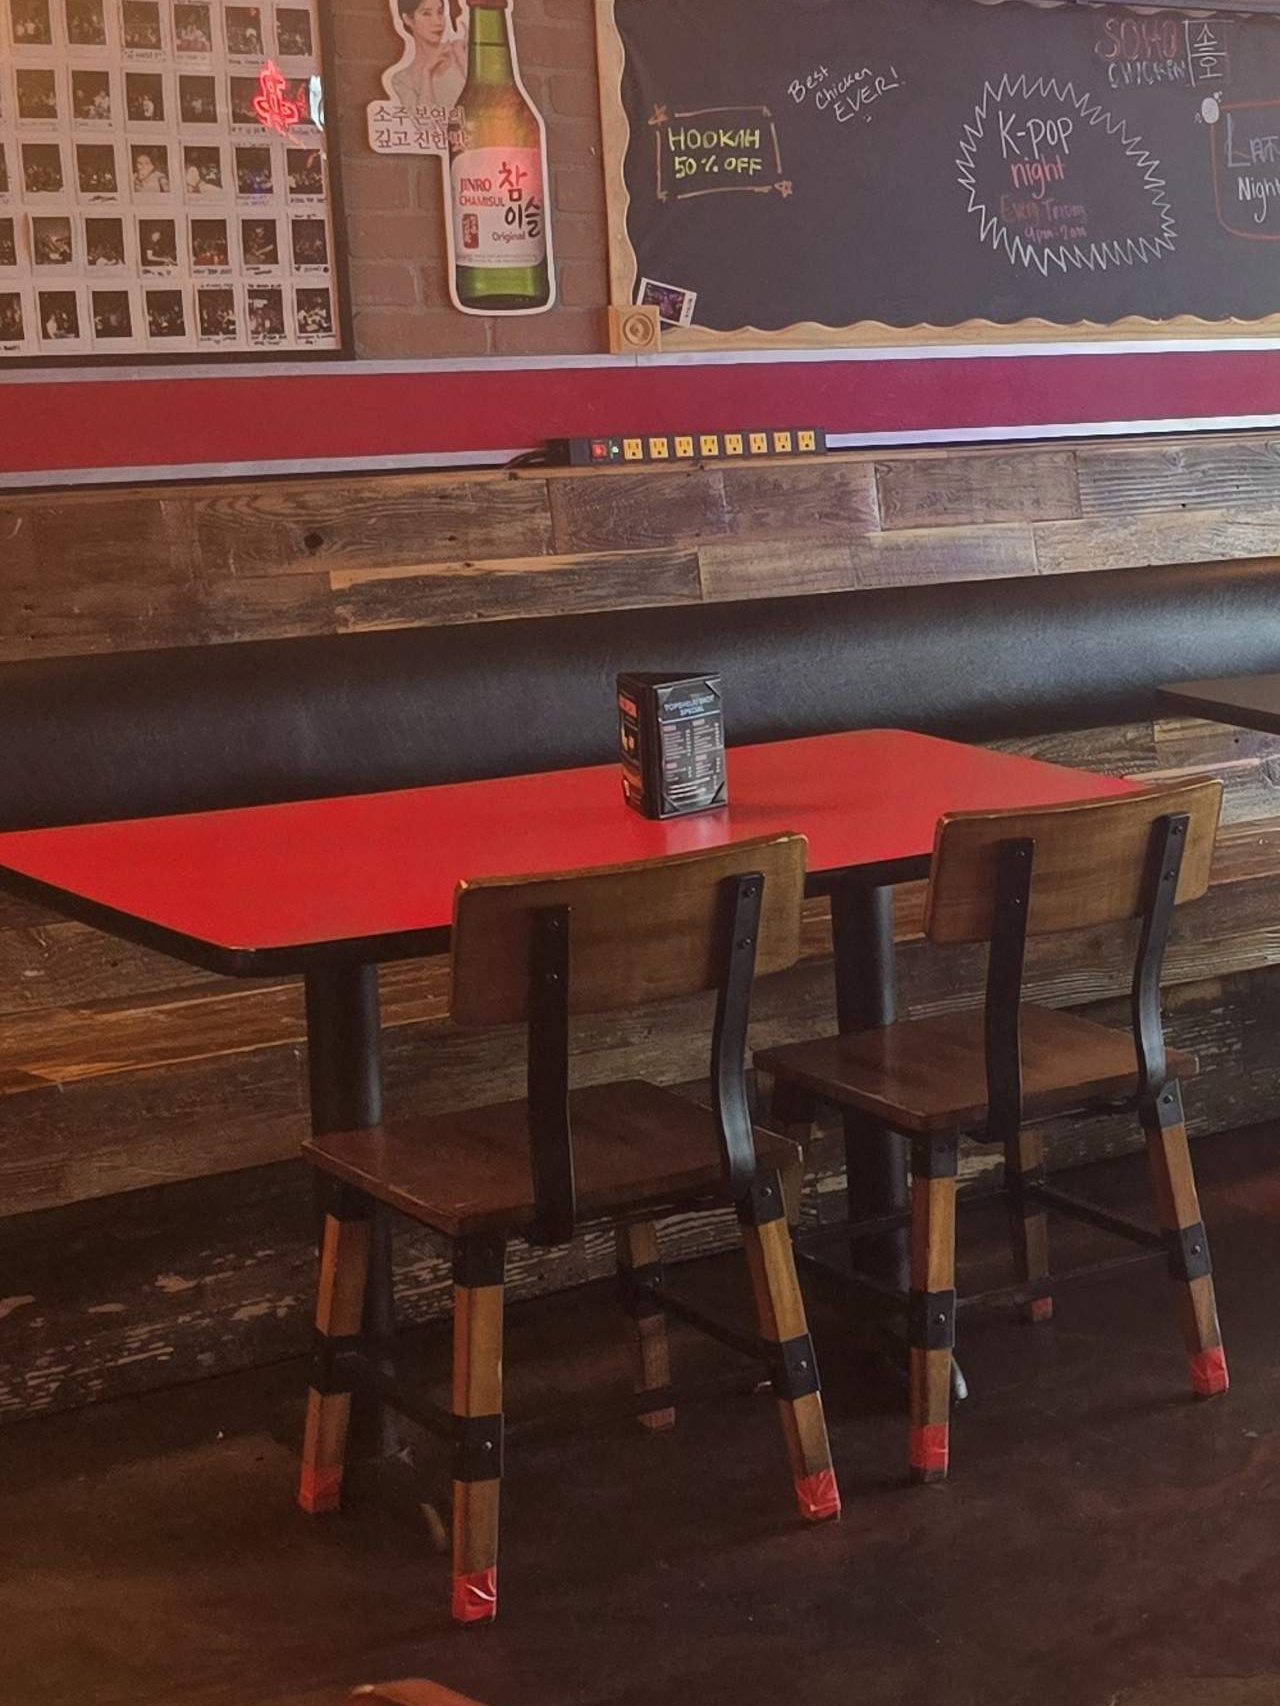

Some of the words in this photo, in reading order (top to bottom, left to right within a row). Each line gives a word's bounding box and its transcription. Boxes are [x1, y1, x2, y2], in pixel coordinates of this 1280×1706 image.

[1095, 18, 1178, 61] SOHO
[787, 65, 830, 104] Best
[815, 67, 873, 111] Chicken
[834, 66, 901, 123] EVER!
[373, 105, 409, 126] 소주
[414, 105, 465, 128] 본연의
[374, 129, 411, 149] 깊고
[667, 126, 761, 151] HOOKAH
[723, 156, 763, 176] OFF
[1010, 154, 1065, 200] night
[460, 177, 492, 192] JINRO
[459, 195, 506, 208] CHAMISUL
[492, 231, 527, 244] Original
